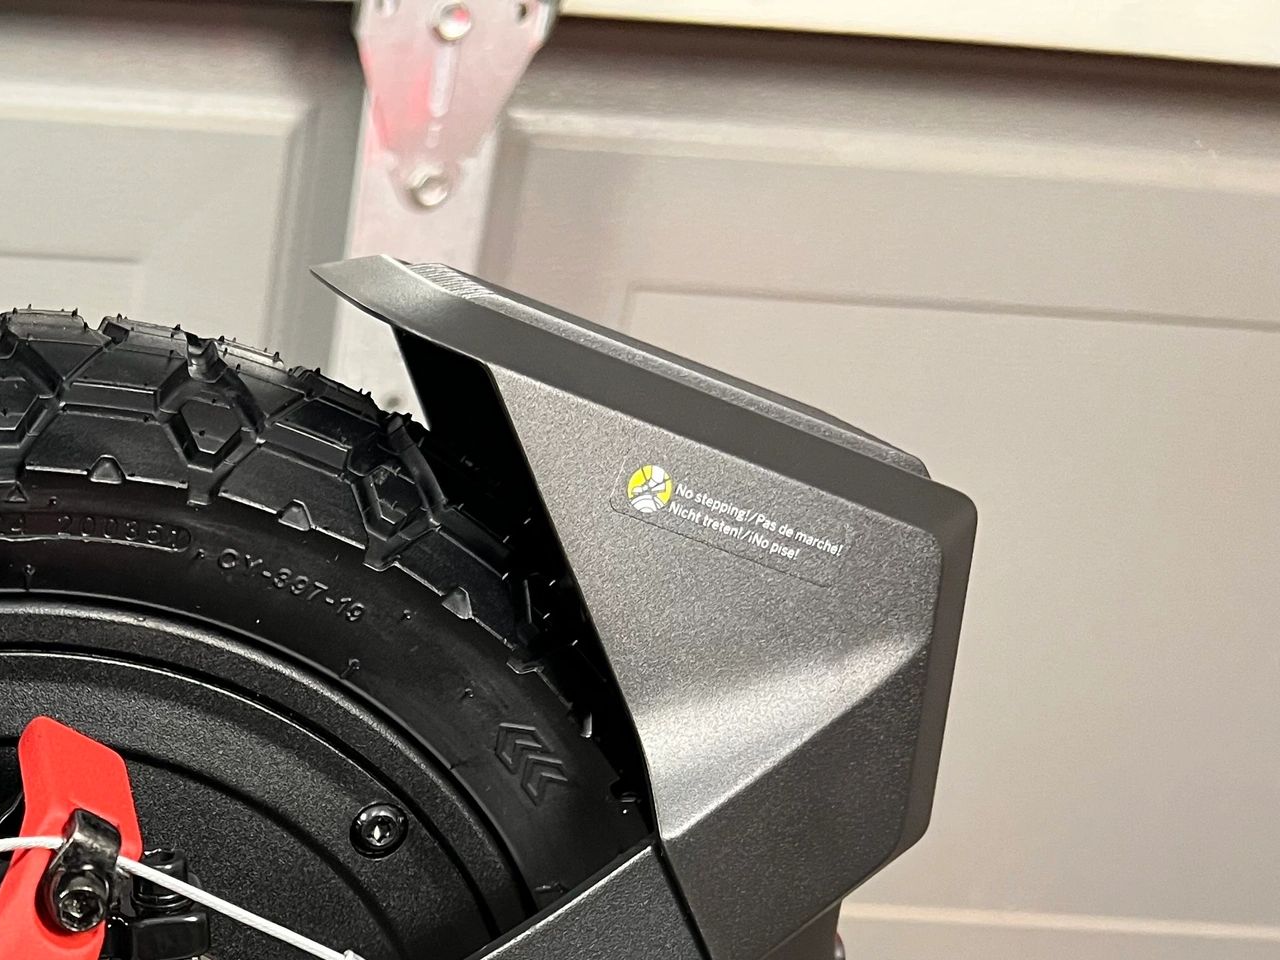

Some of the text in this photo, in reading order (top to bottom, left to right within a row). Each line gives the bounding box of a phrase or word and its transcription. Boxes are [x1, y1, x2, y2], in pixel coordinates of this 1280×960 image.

[668, 501, 704, 526] Nicht
[768, 541, 801, 562] pise!
[675, 482, 694, 501] No
[778, 520, 796, 540] de
[794, 529, 845, 558] marche!
